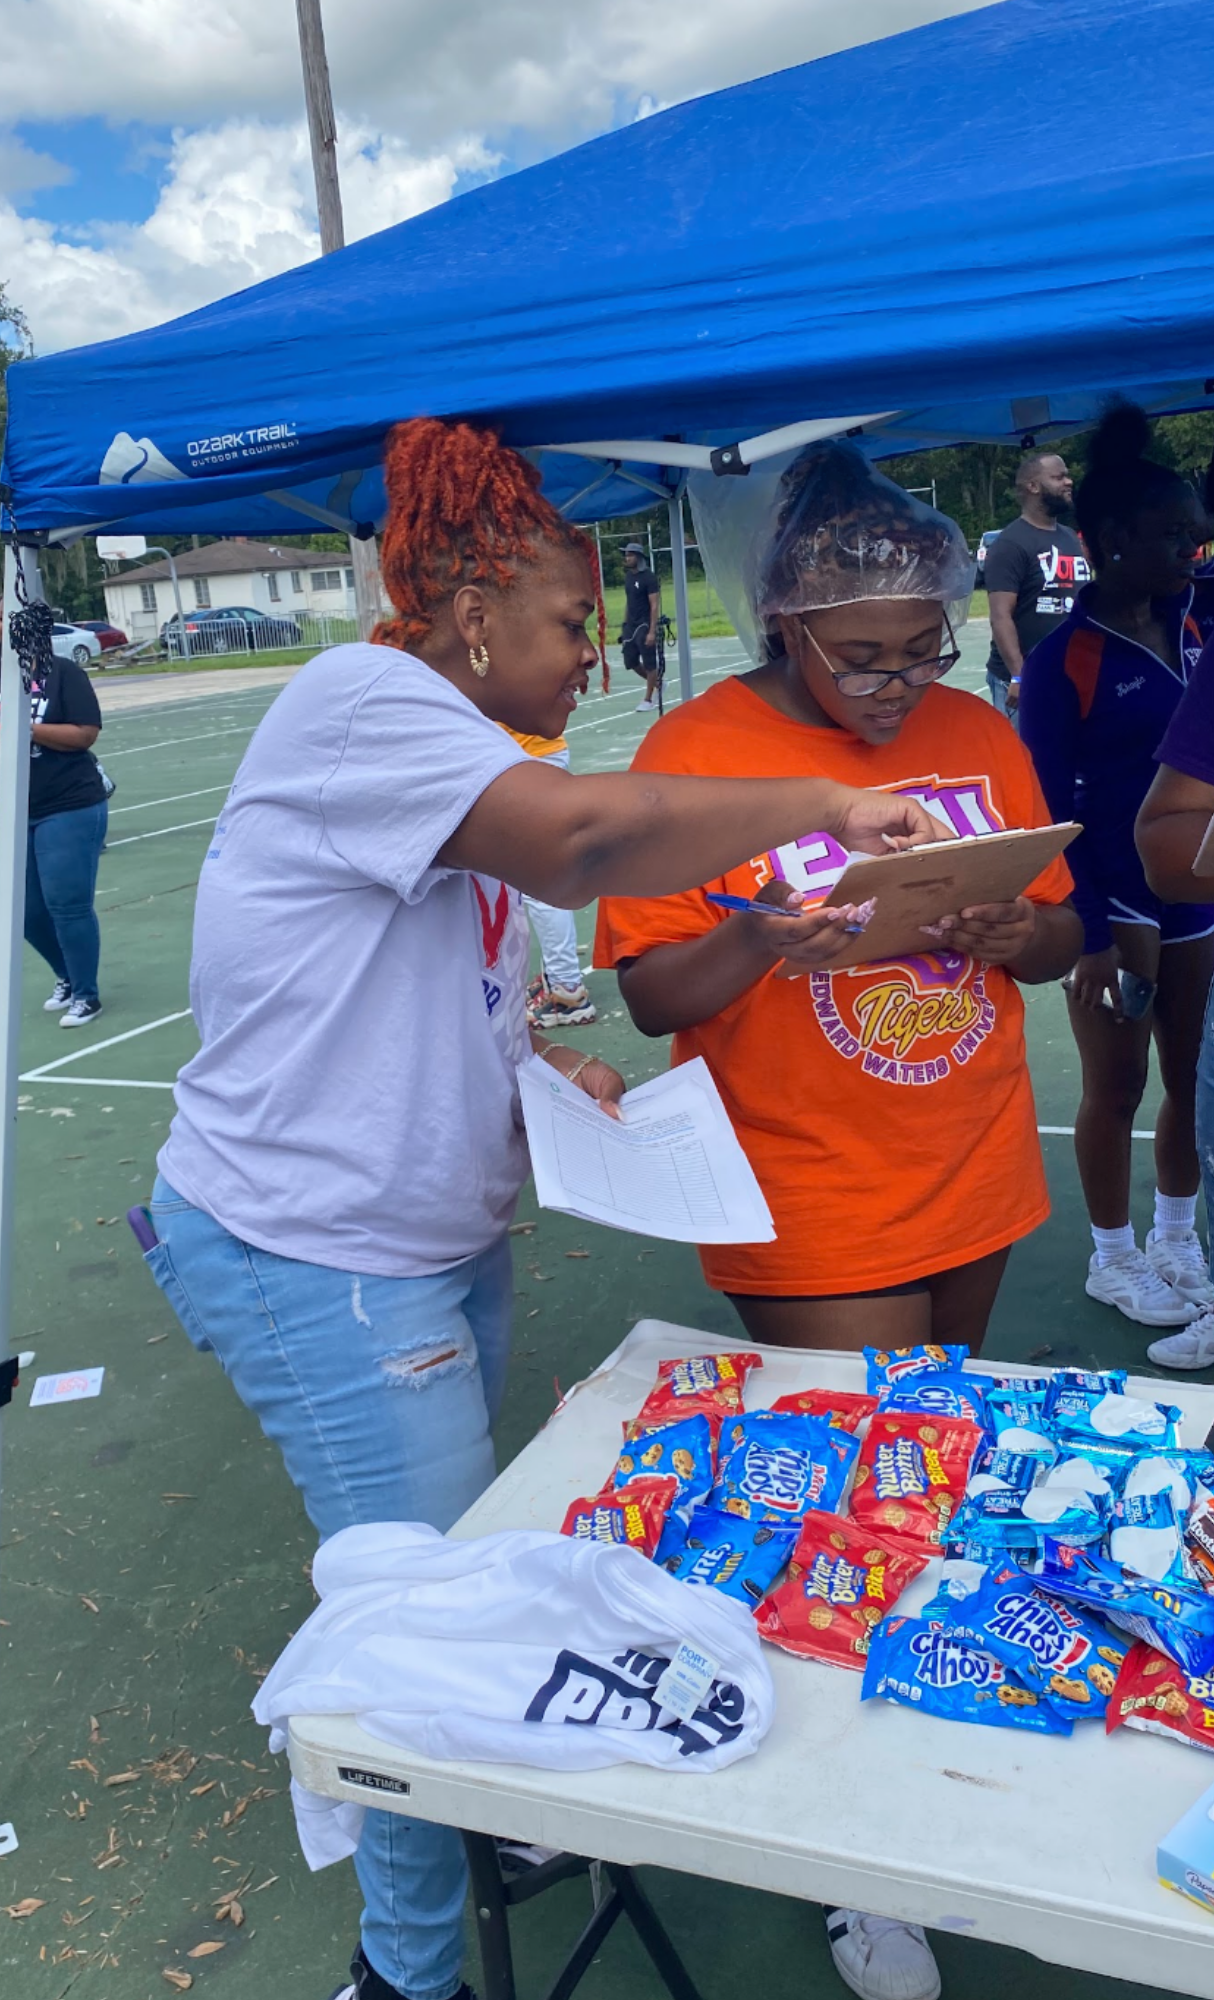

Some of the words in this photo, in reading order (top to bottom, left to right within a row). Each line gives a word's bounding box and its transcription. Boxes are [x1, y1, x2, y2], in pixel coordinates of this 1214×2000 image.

[811, 970, 861, 1058] EDWARD
[862, 1051, 949, 1085] WATERS
[855, 981, 977, 1058] Tigers
[773, 1449, 811, 1502] Chips
[804, 1462, 828, 1503] Mini
[876, 1443, 902, 1499] Nutter
[895, 1438, 924, 1493] Butter
[924, 1447, 950, 1486] Bites
[592, 1507, 616, 1545] utter
[624, 1504, 647, 1541] Bites
[986, 1615, 1090, 1672] Ahoy!
[996, 1595, 1072, 1651] Chips
[677, 1653, 713, 1679] COMPANY
[680, 1645, 709, 1668] PORT
[916, 1651, 1004, 1686] Ahoy!
[347, 1770, 403, 1793] LIFETIME
